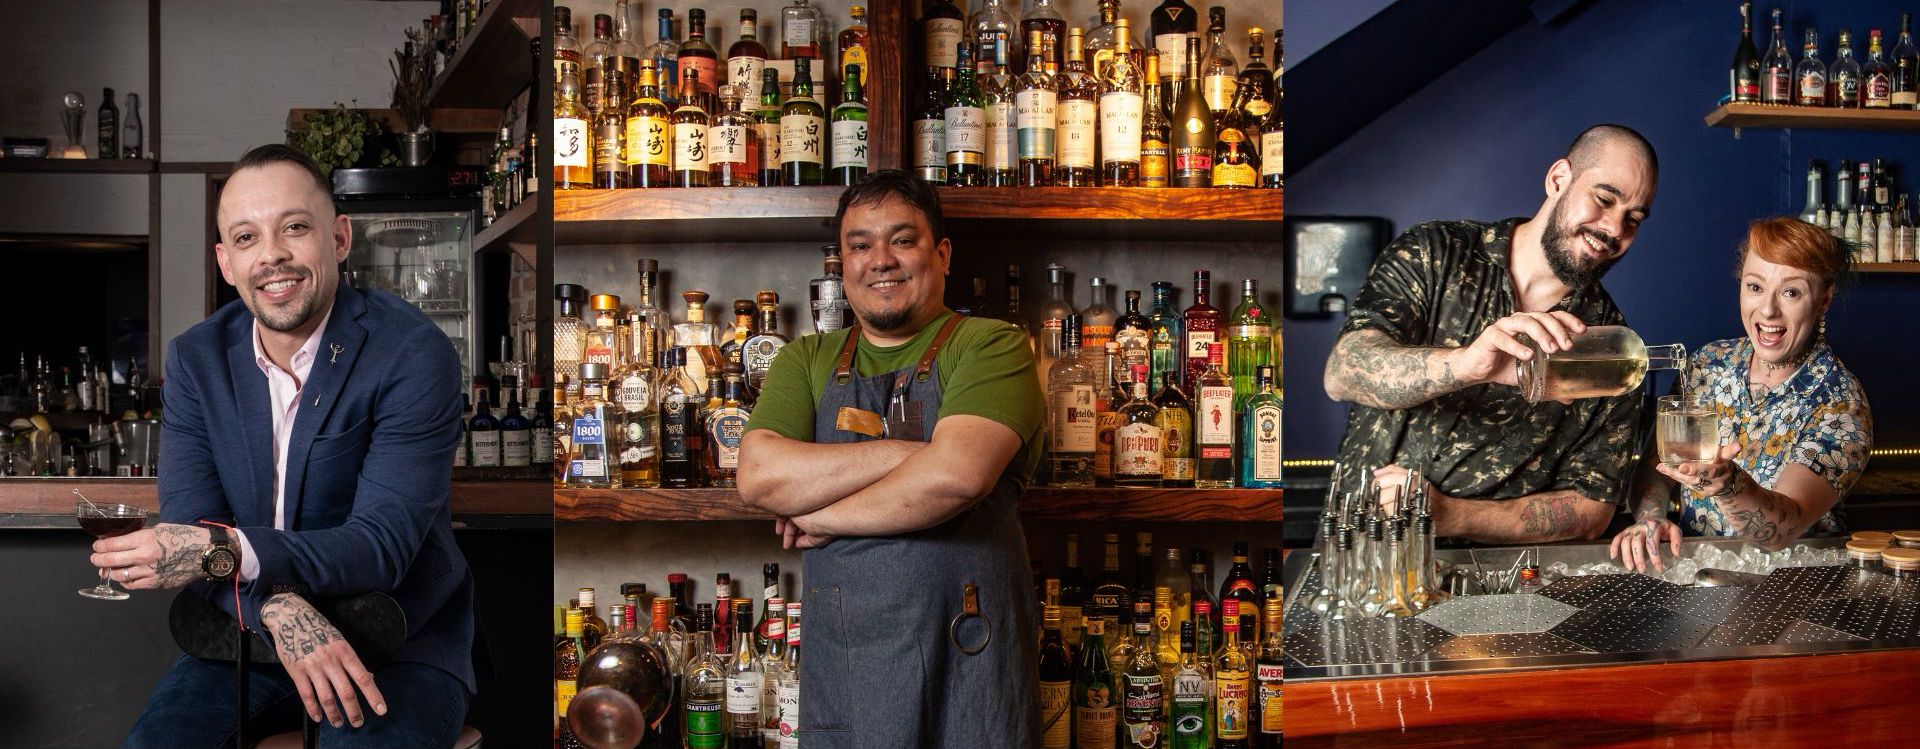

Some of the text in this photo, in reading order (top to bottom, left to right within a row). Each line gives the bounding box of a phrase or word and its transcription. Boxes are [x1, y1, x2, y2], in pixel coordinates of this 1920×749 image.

[804, 120, 819, 156] 白州
[960, 133, 969, 141] 17
[1195, 341, 1208, 351] 24
[587, 354, 611, 363] 1800
[622, 386, 647, 394] GOUVEIA
[1203, 389, 1232, 398] BEEFEATER
[576, 426, 601, 436] 1800
[1259, 667, 1283, 678] AVER
[1218, 687, 1248, 699] LUCANO
